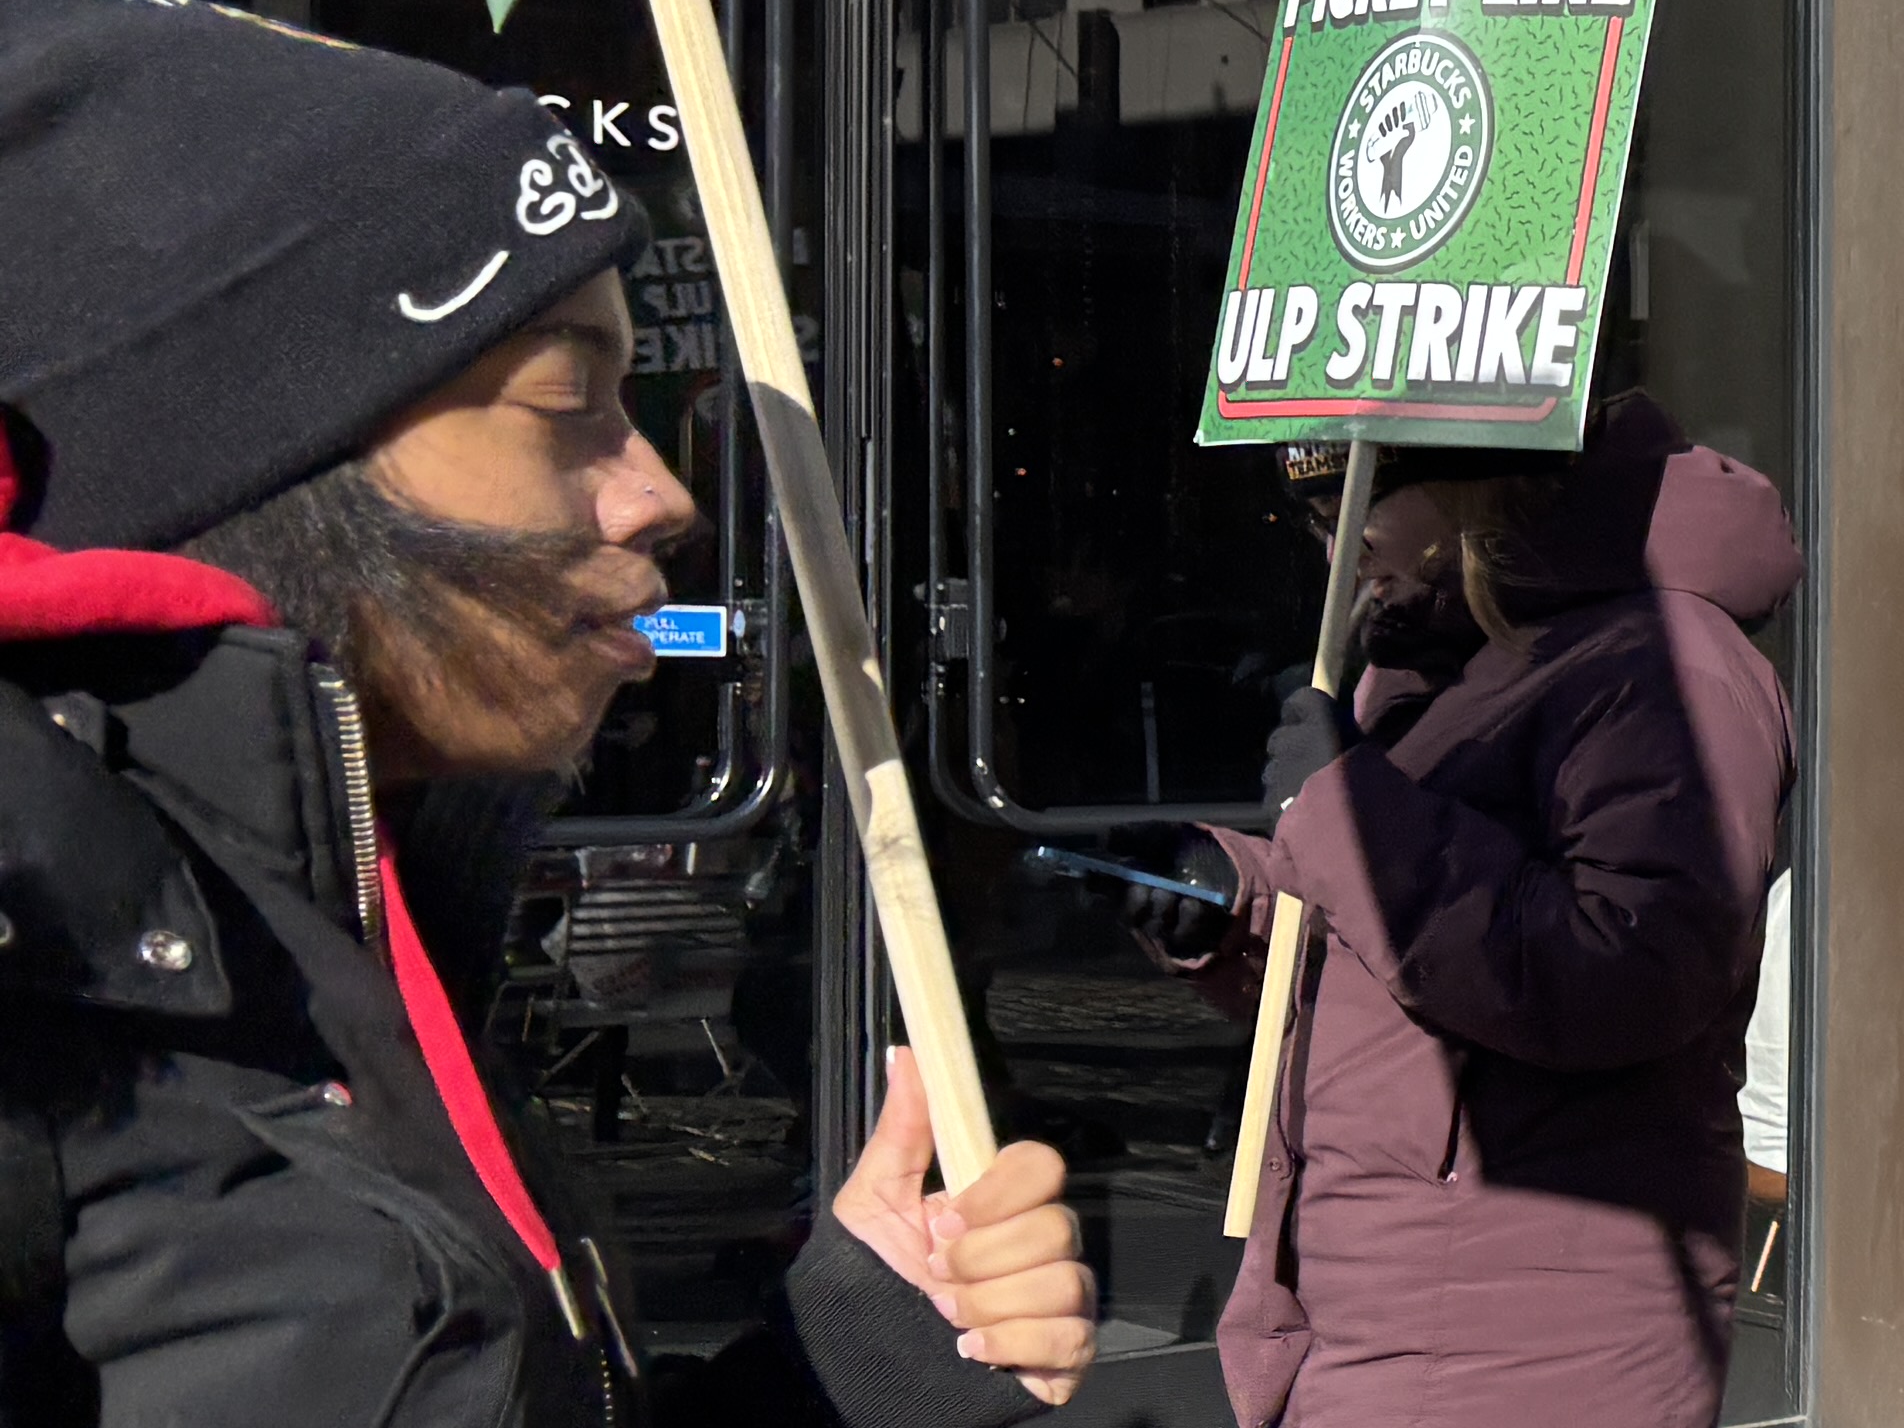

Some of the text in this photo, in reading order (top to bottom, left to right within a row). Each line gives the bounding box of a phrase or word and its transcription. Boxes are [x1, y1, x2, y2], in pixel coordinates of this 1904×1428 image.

[1359, 47, 1473, 113] STARBUCKS
[1338, 149, 1388, 251] WORKERS
[1409, 144, 1473, 240] UNITED
[1217, 281, 1587, 388] ULP STRIKE
